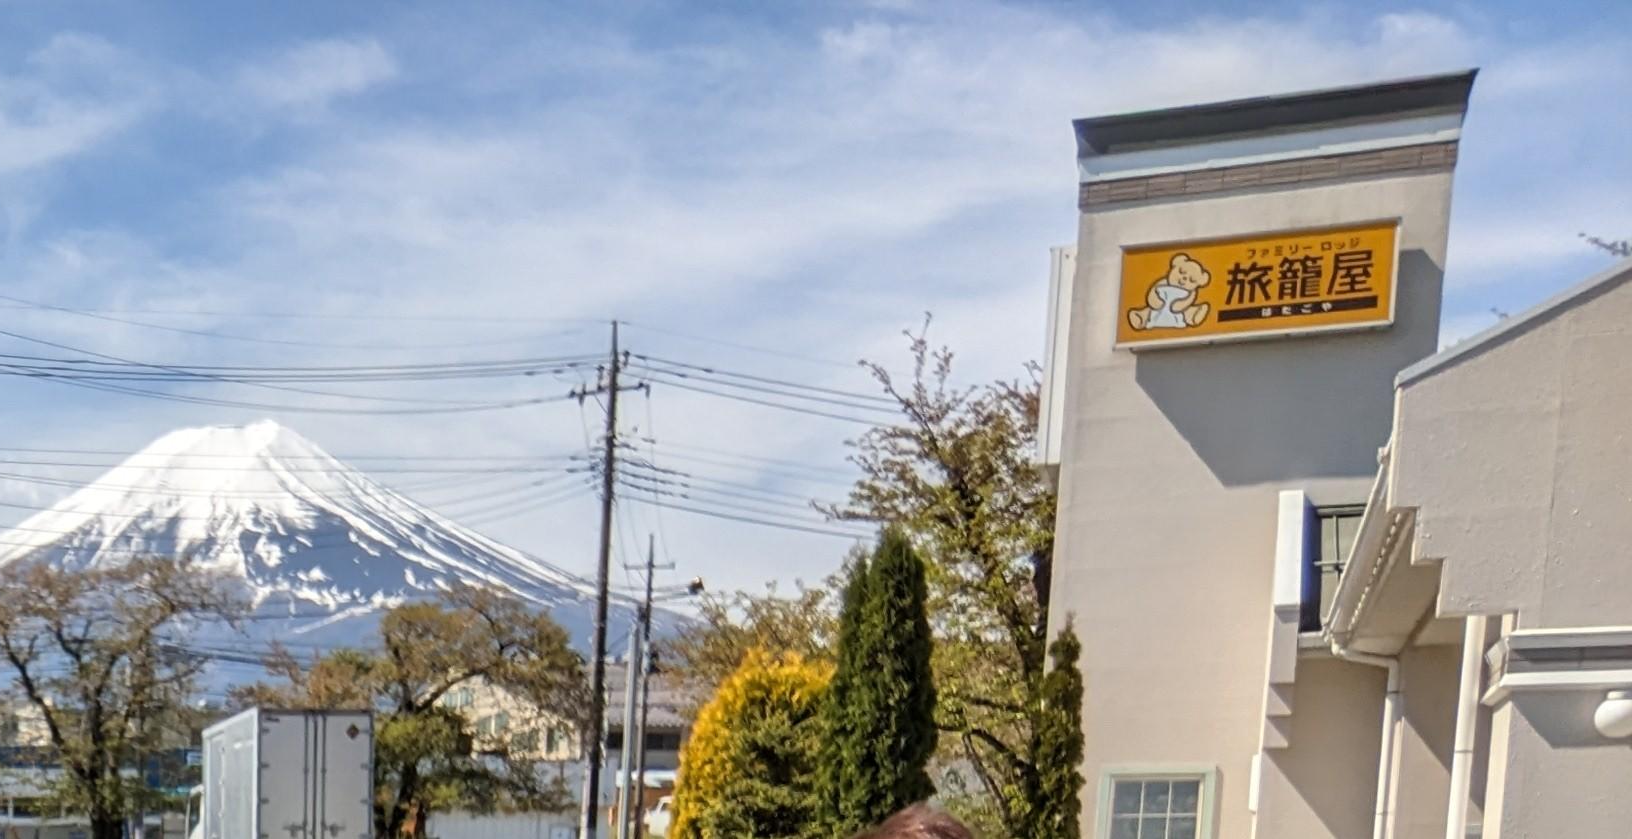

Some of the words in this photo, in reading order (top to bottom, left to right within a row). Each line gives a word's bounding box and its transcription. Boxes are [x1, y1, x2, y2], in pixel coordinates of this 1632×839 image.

[1247, 244, 1312, 259] ファミリー
[1321, 238, 1361, 250] ロッジ
[1225, 249, 1374, 305] 旅籠屋
[1261, 302, 1334, 317] はたごや
